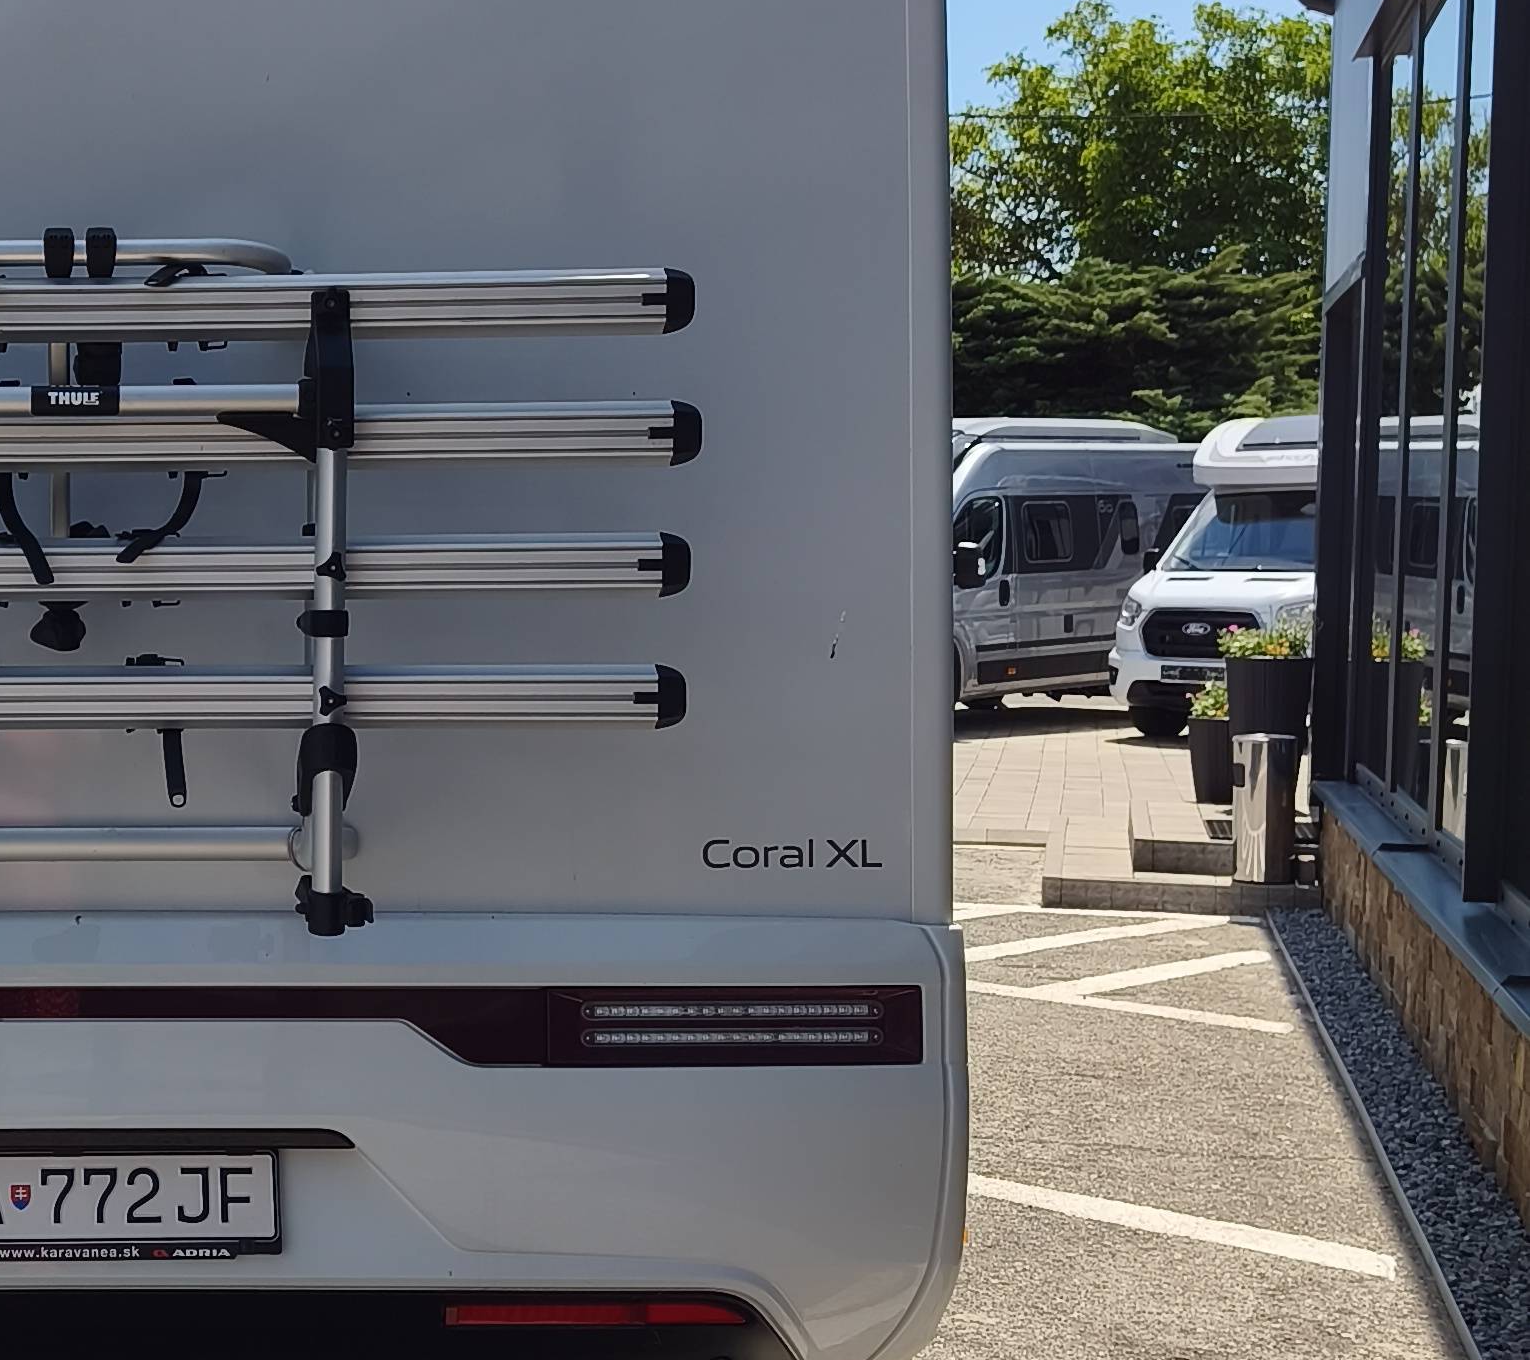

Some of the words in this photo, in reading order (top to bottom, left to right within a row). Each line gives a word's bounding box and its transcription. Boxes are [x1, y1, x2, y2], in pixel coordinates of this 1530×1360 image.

[48, 391, 100, 405] THULE
[702, 838, 814, 869] Coral
[826, 839, 883, 868] XL
[172, 1248, 231, 1257] ADRIA
